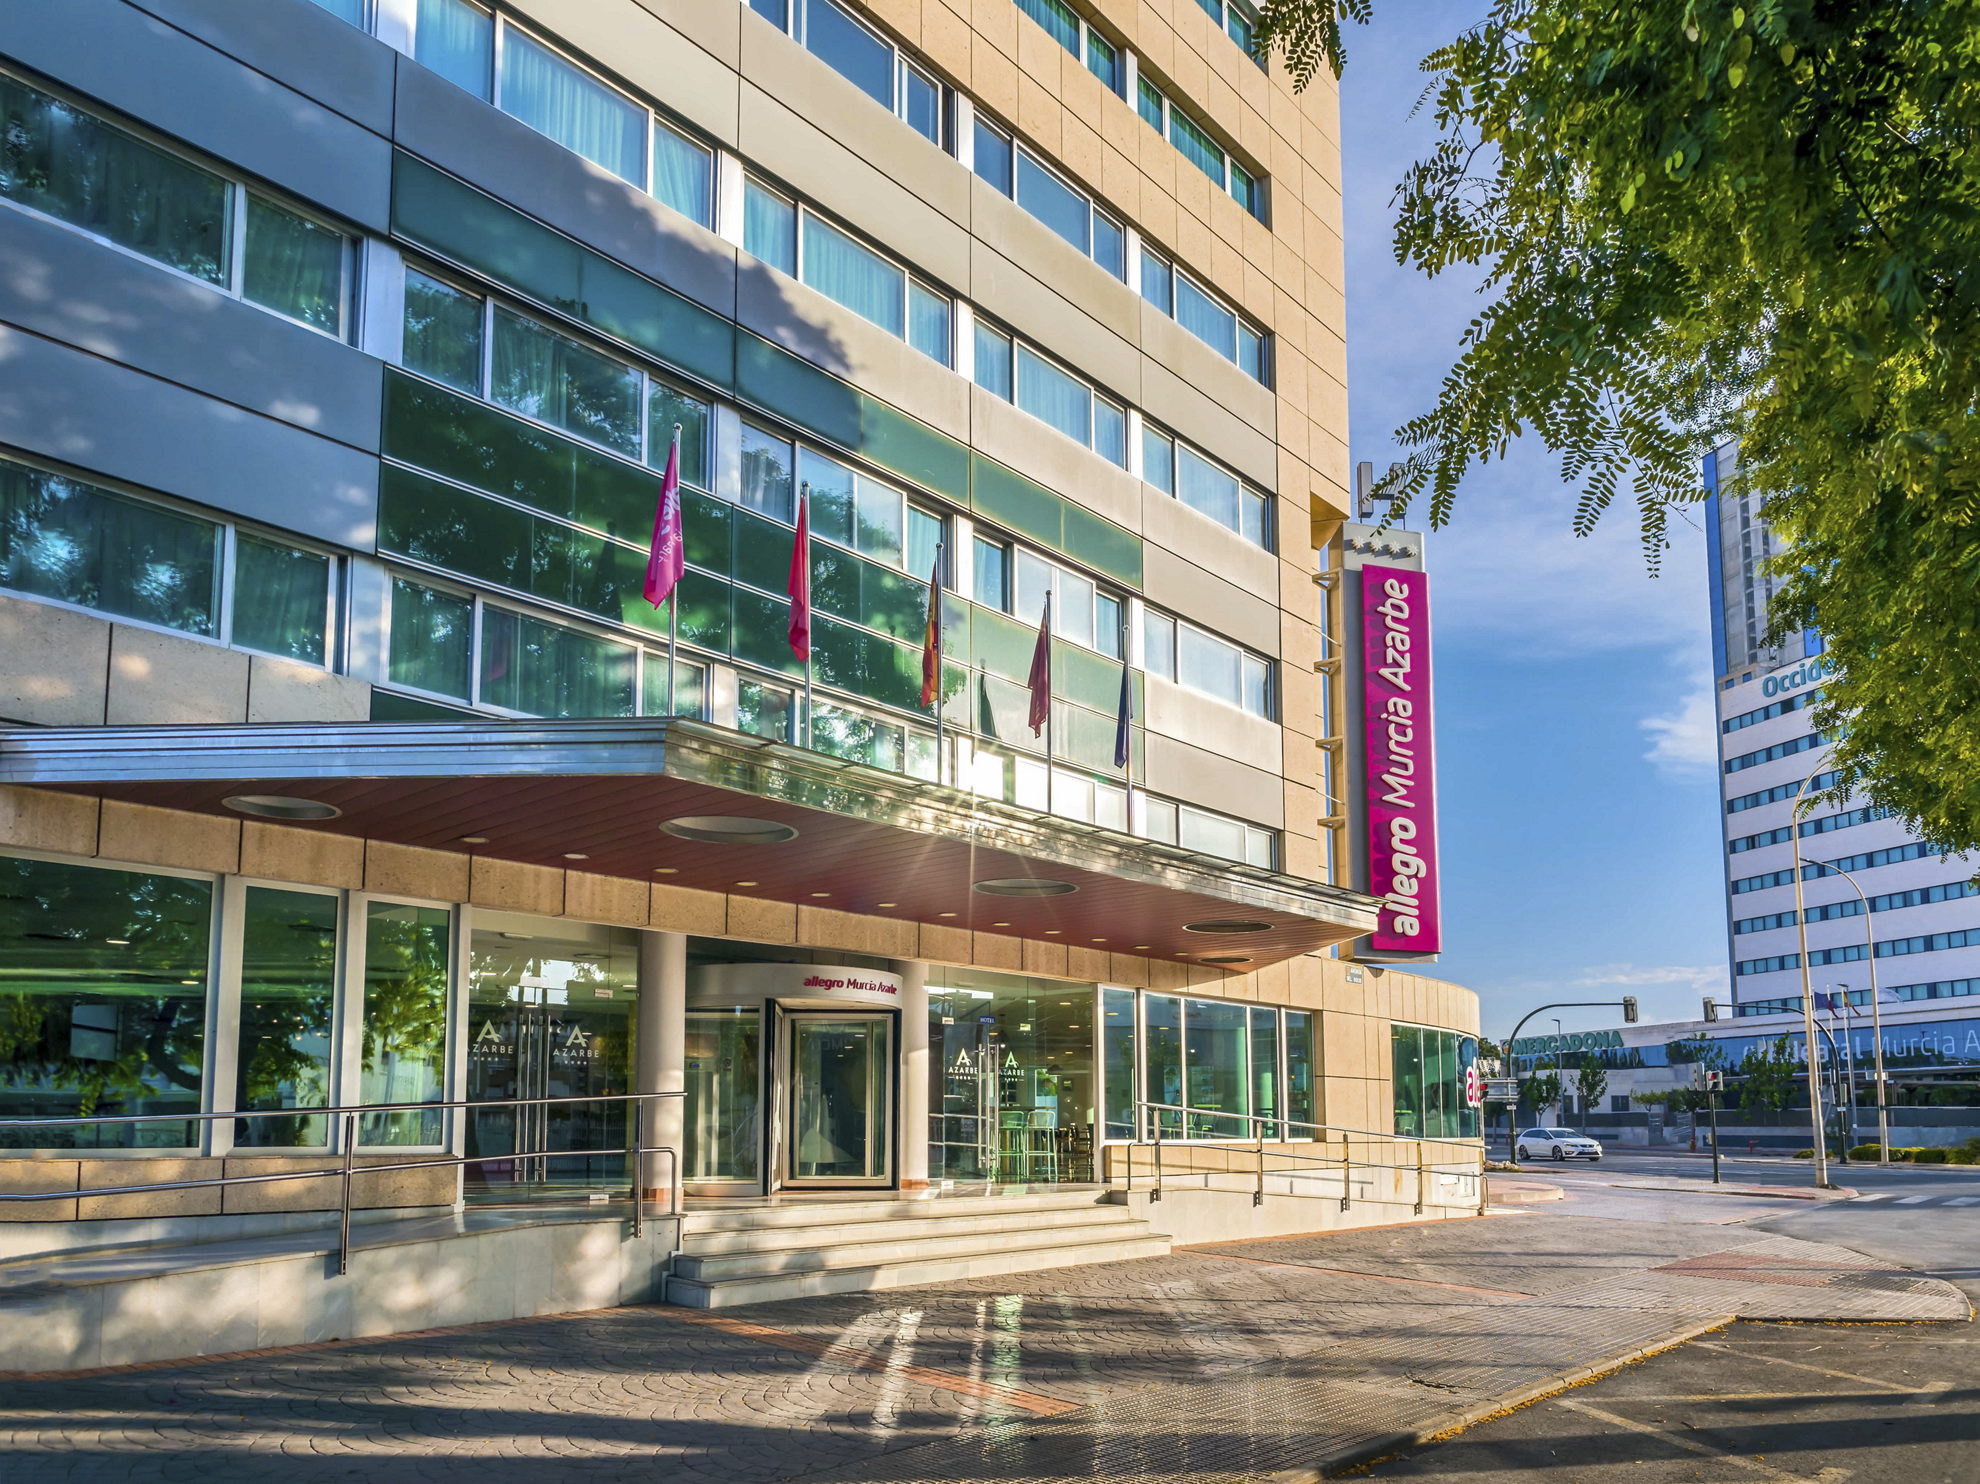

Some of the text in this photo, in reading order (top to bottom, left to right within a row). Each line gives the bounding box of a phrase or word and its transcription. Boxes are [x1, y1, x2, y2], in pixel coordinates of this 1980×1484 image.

[1378, 578, 1426, 937] allegro Murcia Azarbe
[804, 976, 844, 990] allegro
[846, 978, 876, 991] Murcia
[467, 1044, 514, 1054] ZARBE
[1513, 1030, 1624, 1055] MERCADONA
[1872, 1031, 1955, 1059] Murcia
[552, 1048, 599, 1058] AZARBE
[948, 1066, 978, 1074] AZARBE
